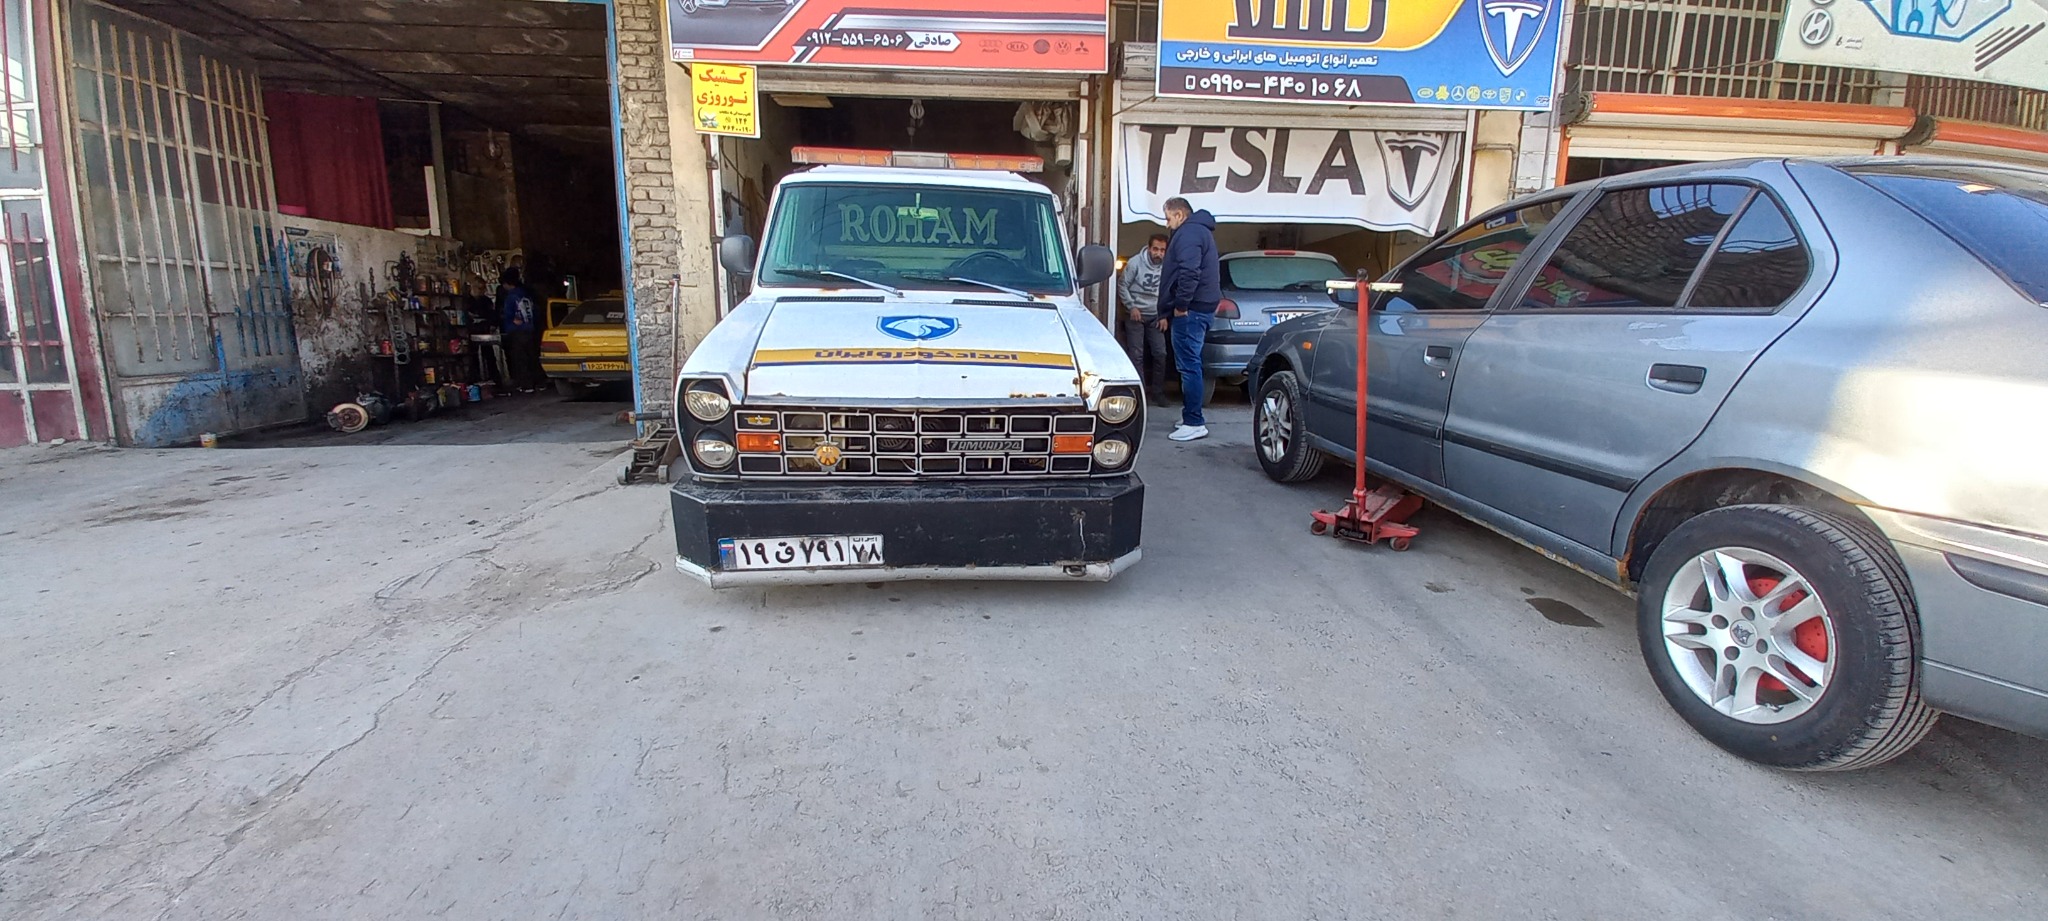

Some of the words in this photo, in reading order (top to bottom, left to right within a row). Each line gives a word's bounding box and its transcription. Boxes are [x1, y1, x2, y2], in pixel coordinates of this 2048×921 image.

[914, 33, 952, 48] صادقی
[1176, 47, 1211, 62] خارجی
[1213, 52, 1220, 62] و
[1222, 50, 1252, 63] ایرانی
[1253, 52, 1277, 65] های
[1278, 51, 1320, 66] اتومبیل
[1321, 54, 1348, 68] انواع
[1348, 54, 1379, 68] تعمیر
[699, 69, 747, 87] کشیک
[696, 90, 748, 107] نوروزی
[1139, 126, 1366, 195] TESLA
[837, 203, 999, 246] ROHAM
[814, 349, 873, 359] ایران
[876, 350, 954, 360] خودرو
[956, 352, 1018, 361] امداد
